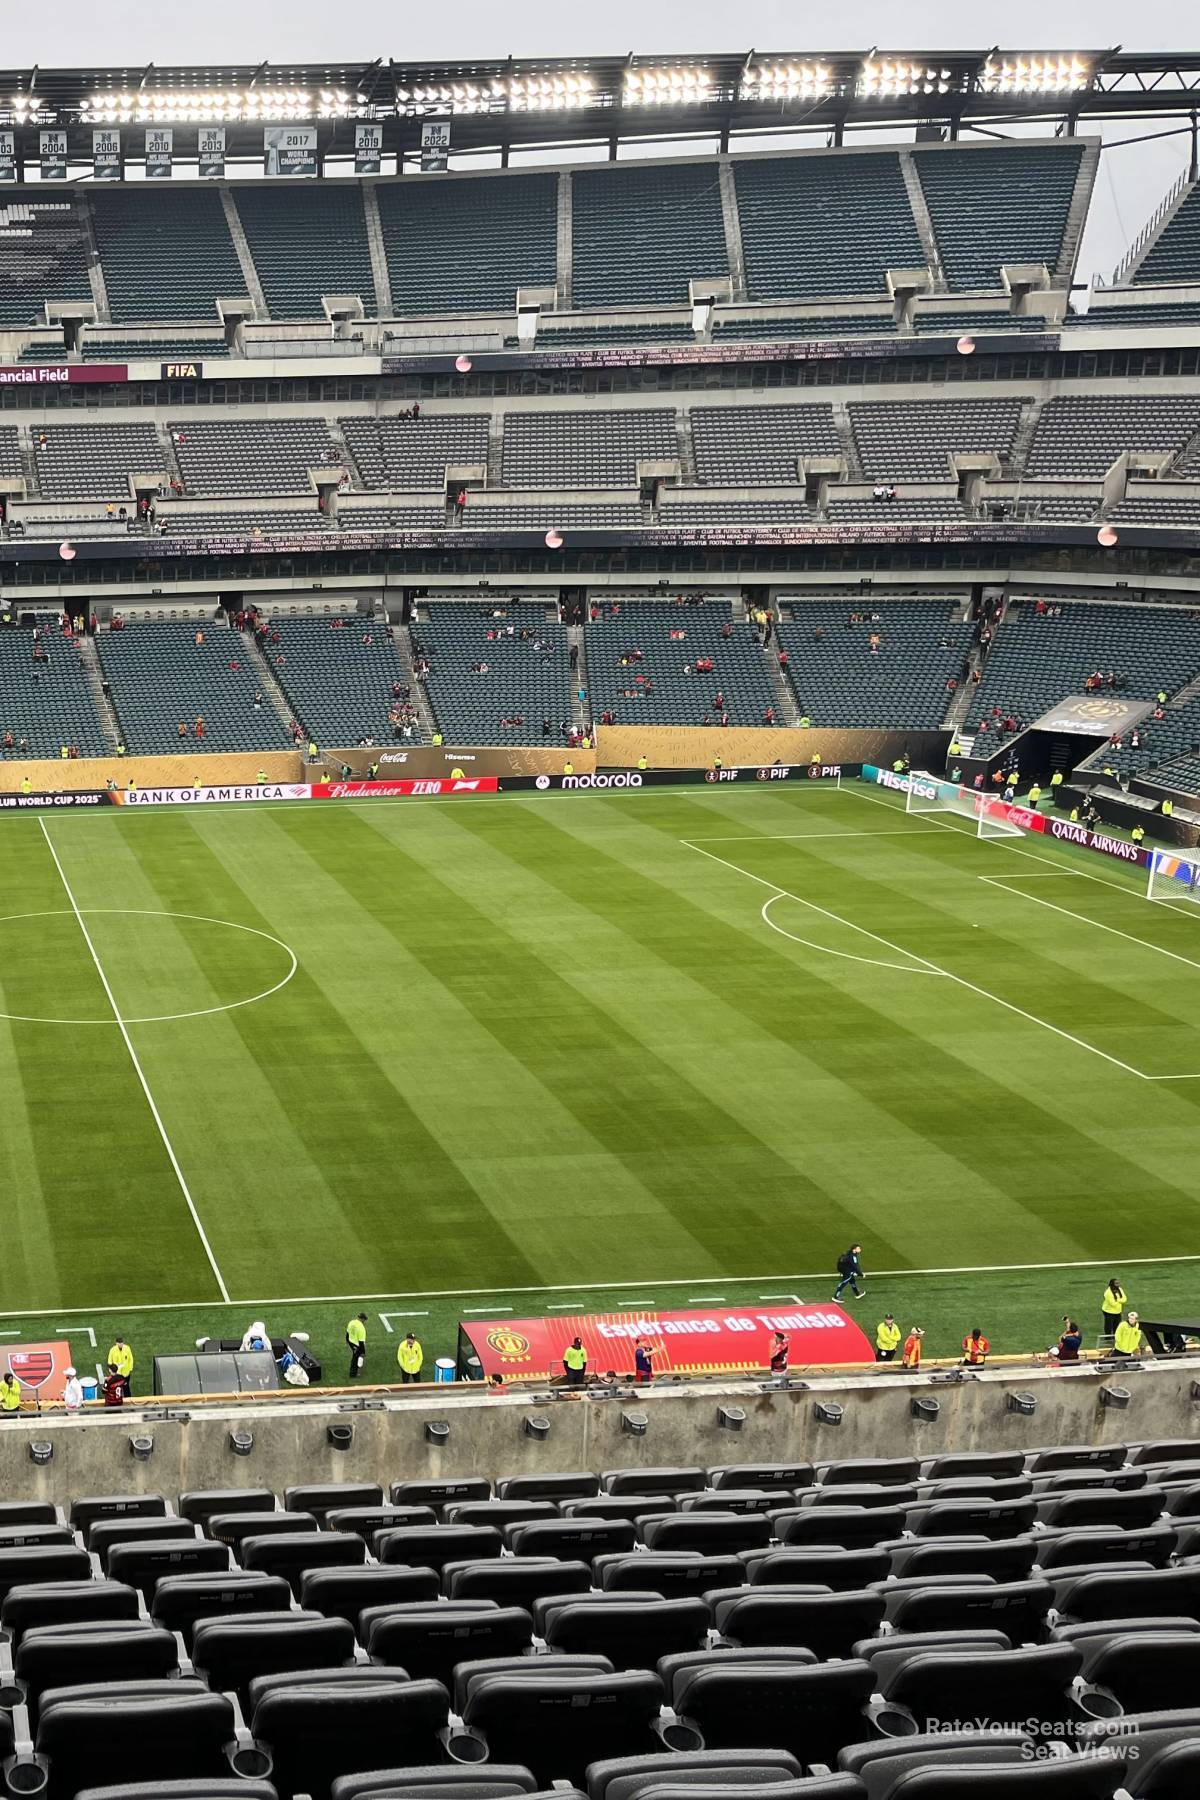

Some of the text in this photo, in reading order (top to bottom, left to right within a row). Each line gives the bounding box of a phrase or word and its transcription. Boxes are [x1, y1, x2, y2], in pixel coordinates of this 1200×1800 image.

[96, 142, 118, 152] 2006
[150, 142, 169, 152] 2010
[202, 141, 221, 150] 2013
[287, 136, 309, 146] 2017
[359, 138, 378, 147] 2019
[424, 136, 447, 146] 2022
[43, 144, 64, 153] 2004
[280, 157, 315, 165] CHAMPIONS
[40, 368, 69, 382] Field
[167, 364, 198, 377] FIFA
[380, 752, 408, 764] Coca-Cola
[444, 752, 476, 761] Hisense
[718, 768, 738, 781] PIF
[770, 767, 790, 779] PIF
[822, 765, 840, 776] PIF
[562, 772, 642, 788] motorola
[877, 769, 936, 800] Hisense
[129, 786, 284, 803] BANK OF AMERICA
[328, 781, 440, 798] Budweiser ZERO
[18, 796, 52, 806] WORLD
[54, 796, 74, 805] CUP
[1006, 809, 1032, 828] Coca-Cola
[1052, 821, 1138, 862] QATAR AIRWAYS
[597, 1312, 846, 1339] Espérance de Tunisie
